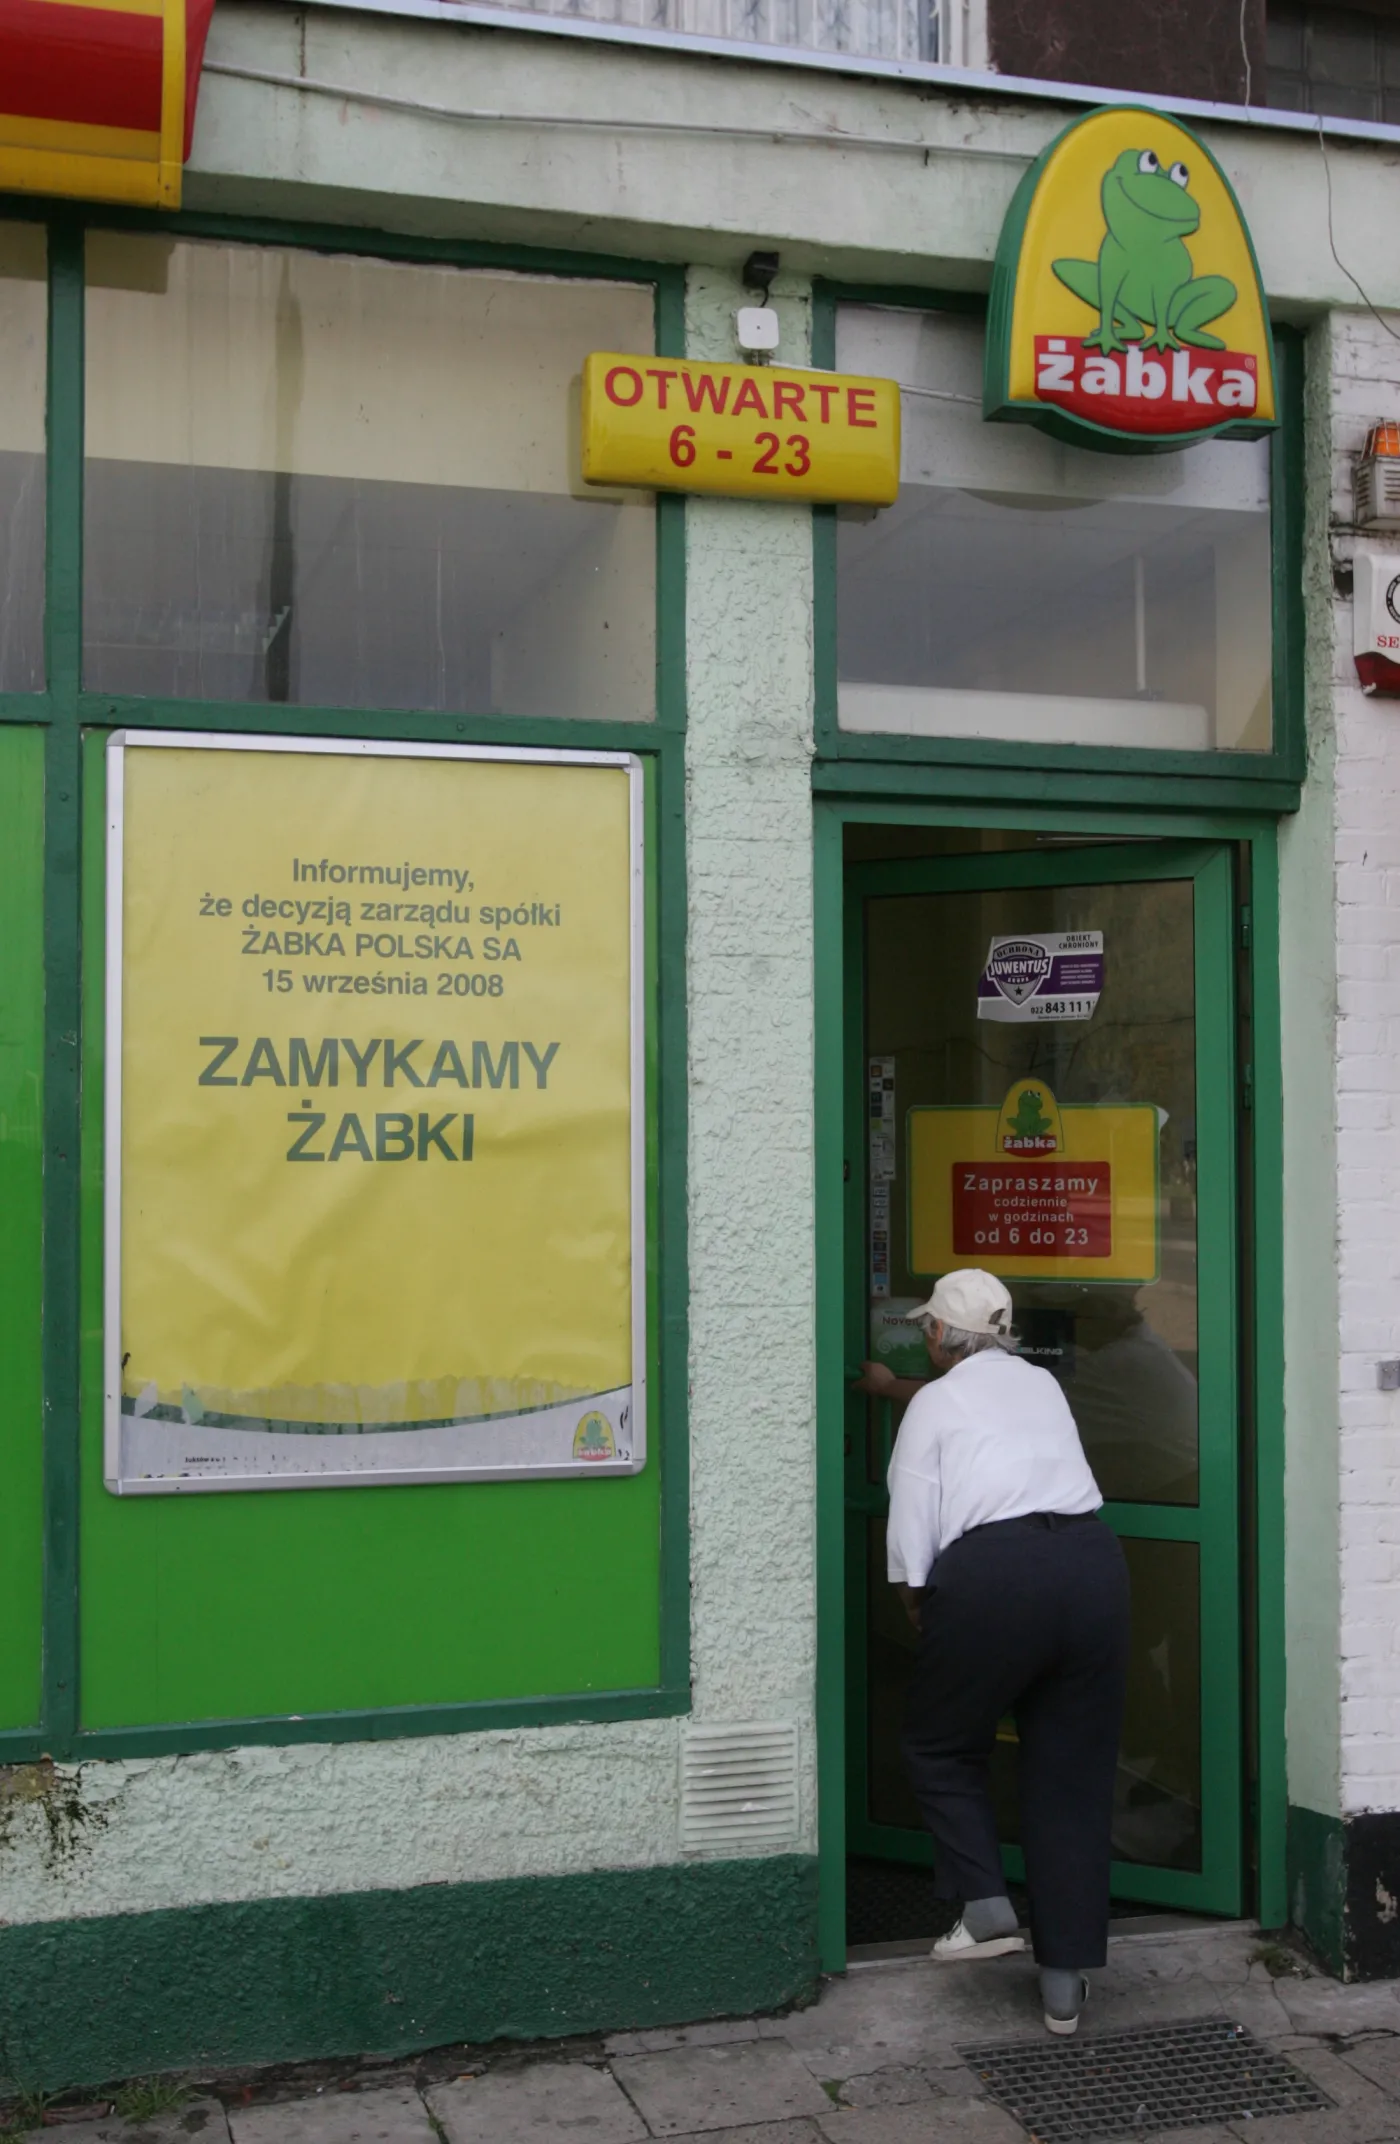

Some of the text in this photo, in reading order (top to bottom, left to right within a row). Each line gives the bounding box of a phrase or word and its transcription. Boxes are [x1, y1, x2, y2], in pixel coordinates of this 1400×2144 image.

[1038, 339, 1256, 408] żabka
[604, 366, 877, 428] OTWARTE
[669, 424, 696, 467] 6
[752, 432, 811, 477] 23
[293, 859, 475, 893] Informujemy,
[199, 893, 561, 931] że decyzją zarządu spółki
[241, 924, 522, 961] ŻABKA POLSKA SA
[1058, 941, 1099, 949] CHRONIONY
[1066, 934, 1091, 942] OBIEKT
[996, 945, 1040, 958] OCHRONA
[990, 959, 1049, 976] JUWENTUS
[262, 969, 504, 997] 15 września 2008
[1030, 1006, 1044, 1015] 022
[1045, 1002, 1066, 1014] 843
[198, 1036, 561, 1090] ZAMYKAMY
[286, 1099, 474, 1162] ŻABKI
[1003, 1136, 1057, 1149] żabka
[963, 1173, 1098, 1195] Zapraszamy
[994, 1196, 1068, 1208] codziennie
[988, 1211, 1074, 1224] w godzinach
[974, 1228, 1089, 1245] od 6 do 23
